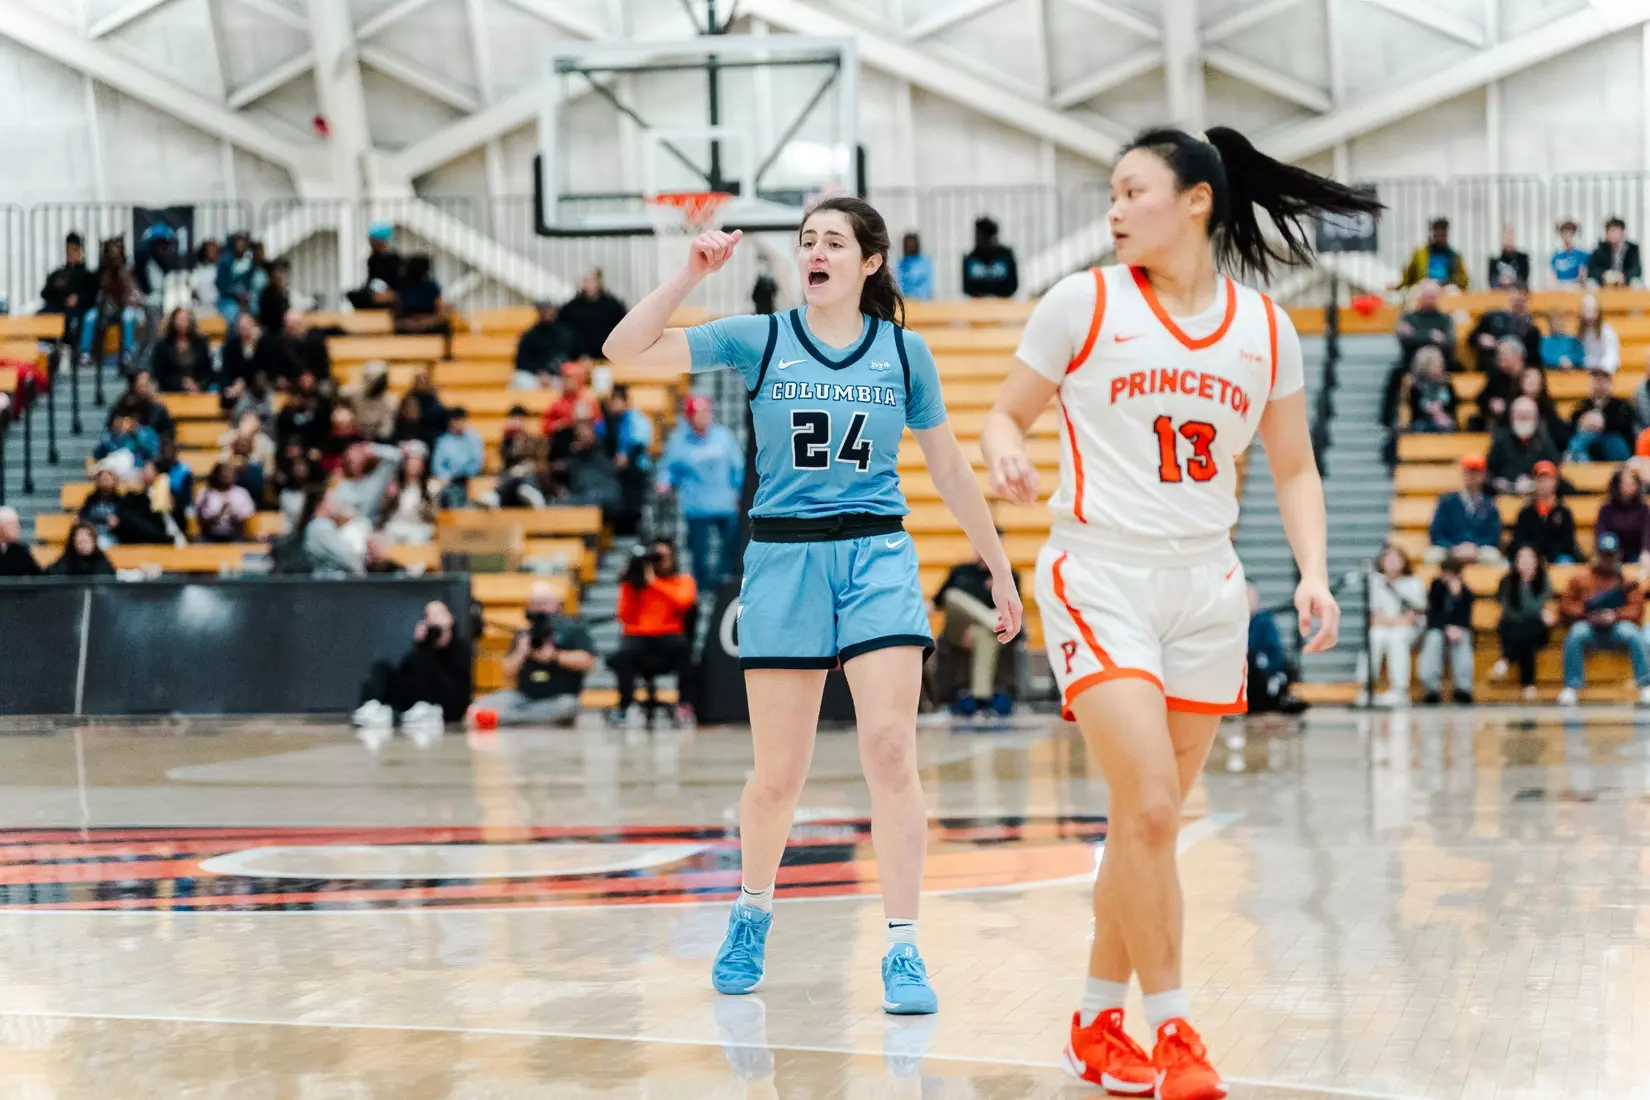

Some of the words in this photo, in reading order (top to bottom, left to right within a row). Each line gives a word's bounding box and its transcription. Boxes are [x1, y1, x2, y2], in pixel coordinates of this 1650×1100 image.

[771, 381, 897, 406] COLUMBIA
[790, 409, 874, 472] 24
[1153, 414, 1218, 482] 13
[1061, 640, 1077, 674] P
